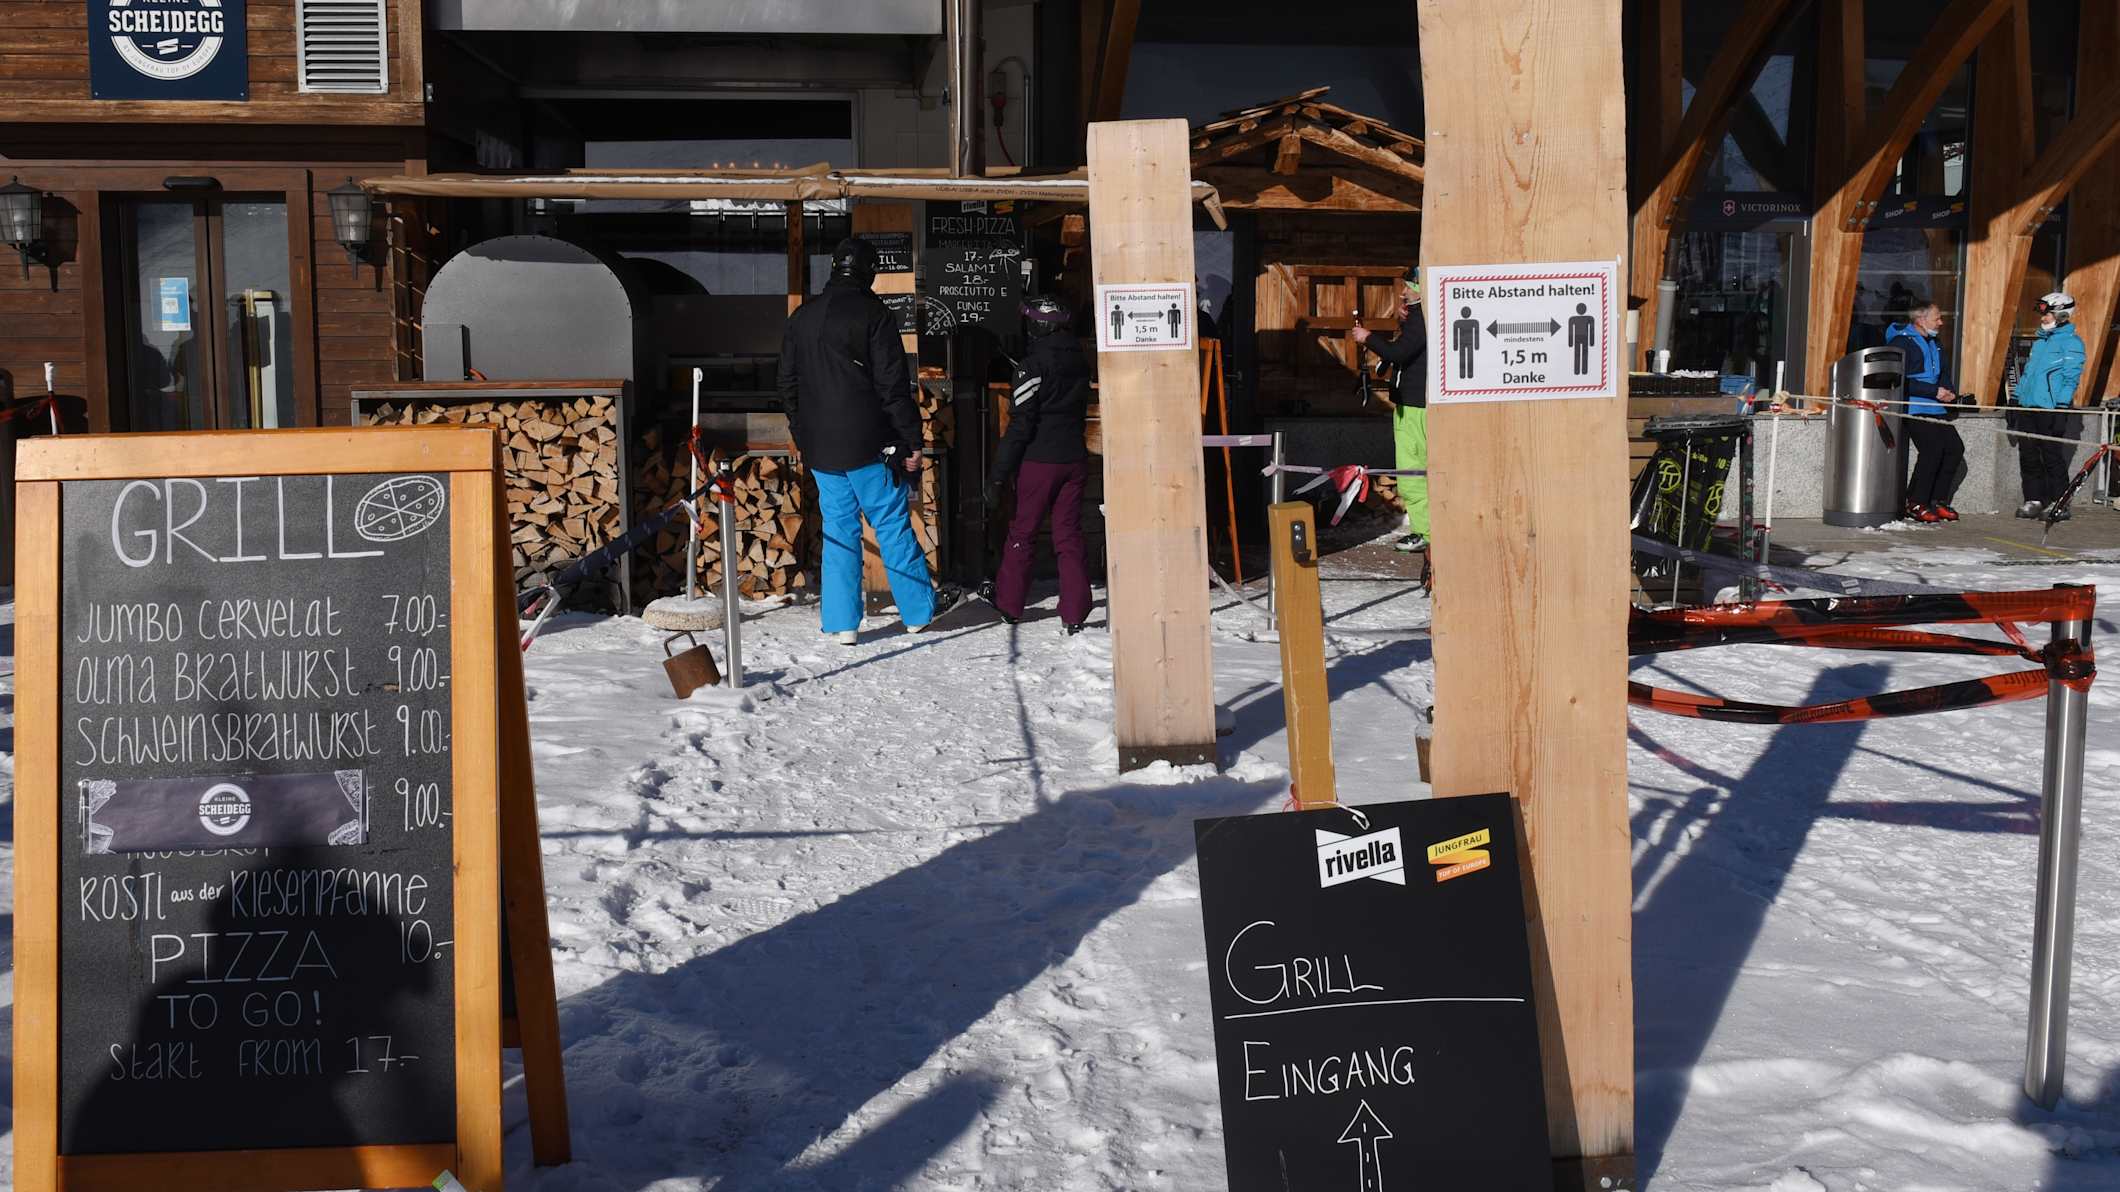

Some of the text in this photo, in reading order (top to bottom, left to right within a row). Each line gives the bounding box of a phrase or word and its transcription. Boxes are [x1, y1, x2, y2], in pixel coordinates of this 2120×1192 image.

[109, 10, 224, 33] SCHEIDEGG
[1740, 203, 1801, 213] VICTORINOX
[1885, 208, 1905, 219] SHOP
[1932, 209, 1951, 220] SHOP
[932, 216, 1016, 235] FRESH PIZZA
[879, 255, 898, 265] ILL
[945, 263, 996, 274] SALAMI
[939, 286, 1008, 297] PROSCIUTTO E
[1110, 294, 1126, 302] Bitte
[1127, 294, 1156, 302] Abstand
[1452, 283, 1595, 300] Bitte Abstand halten!
[957, 301, 991, 312] FUNGI
[1135, 325, 1148, 334] 1,5
[1503, 335, 1545, 344] mindestens
[1501, 350, 1548, 366] 1,5 m
[1502, 371, 1546, 385] Danke
[112, 474, 385, 568] GRILL
[198, 803, 252, 816] SCHEIDEGG
[1434, 834, 1482, 857] JUNGFRAU
[1325, 839, 1397, 878] rivella
[1439, 869, 1452, 879] TOP
[1452, 866, 1461, 874] OF
[170, 888, 195, 903] aus
[198, 881, 226, 902] der
[151, 929, 338, 985] PIZZA
[1225, 920, 1384, 1005] GRILL
[156, 992, 218, 1030] TO
[1243, 1040, 1416, 1102] EINGANG
